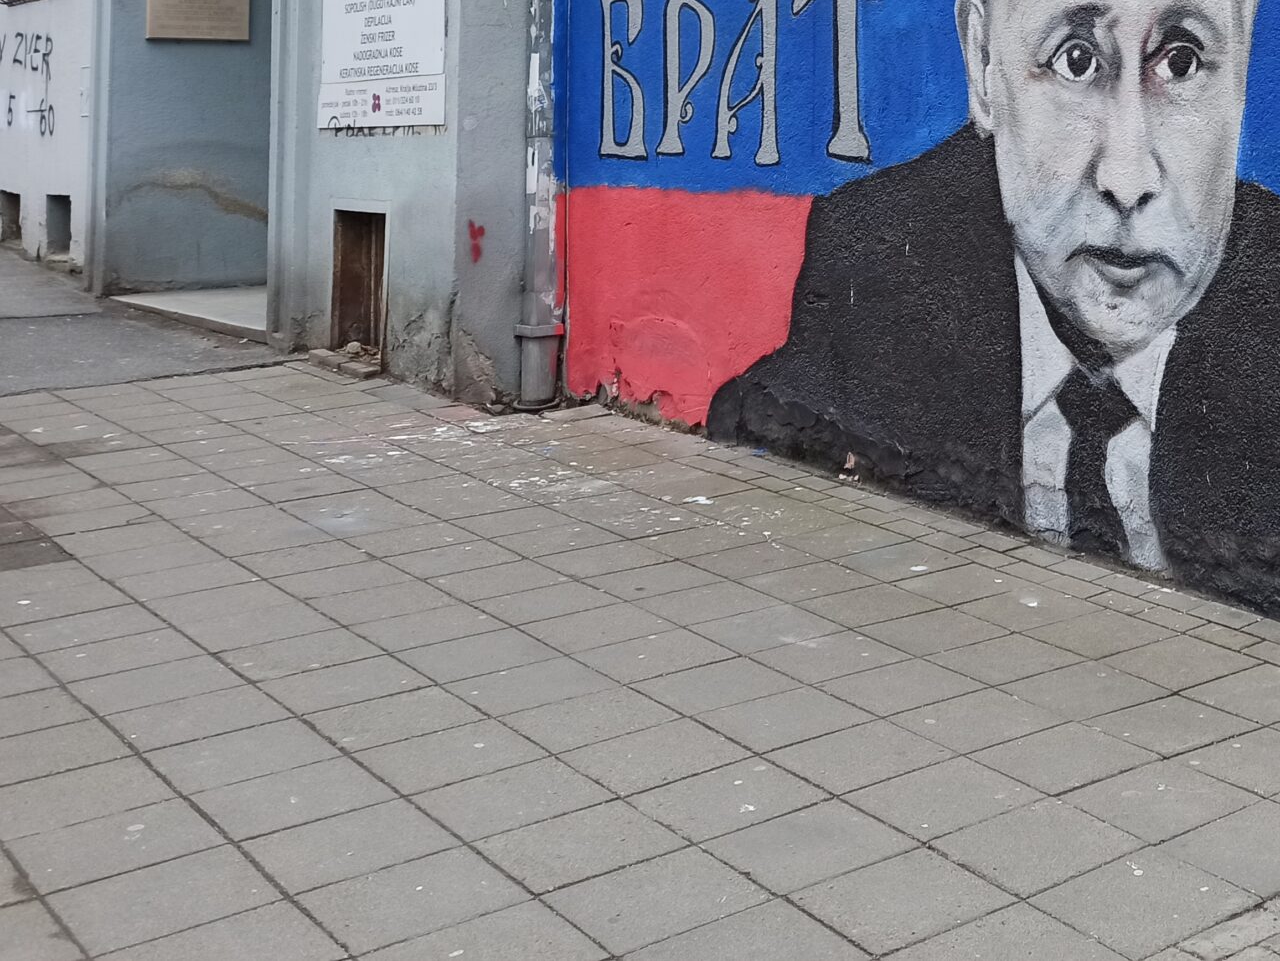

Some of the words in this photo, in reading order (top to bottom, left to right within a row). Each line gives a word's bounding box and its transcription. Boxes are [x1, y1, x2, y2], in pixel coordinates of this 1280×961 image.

[364, 14, 392, 28] DEPILACIJA
[378, 30, 396, 42] FRIZER
[353, 49, 388, 61] NADOGRADNJA
[389, 46, 403, 58] KOSE
[339, 66, 366, 79] KERATINSKA
[367, 63, 404, 76] REGENERACIJA
[405, 62, 419, 73] KOSE
